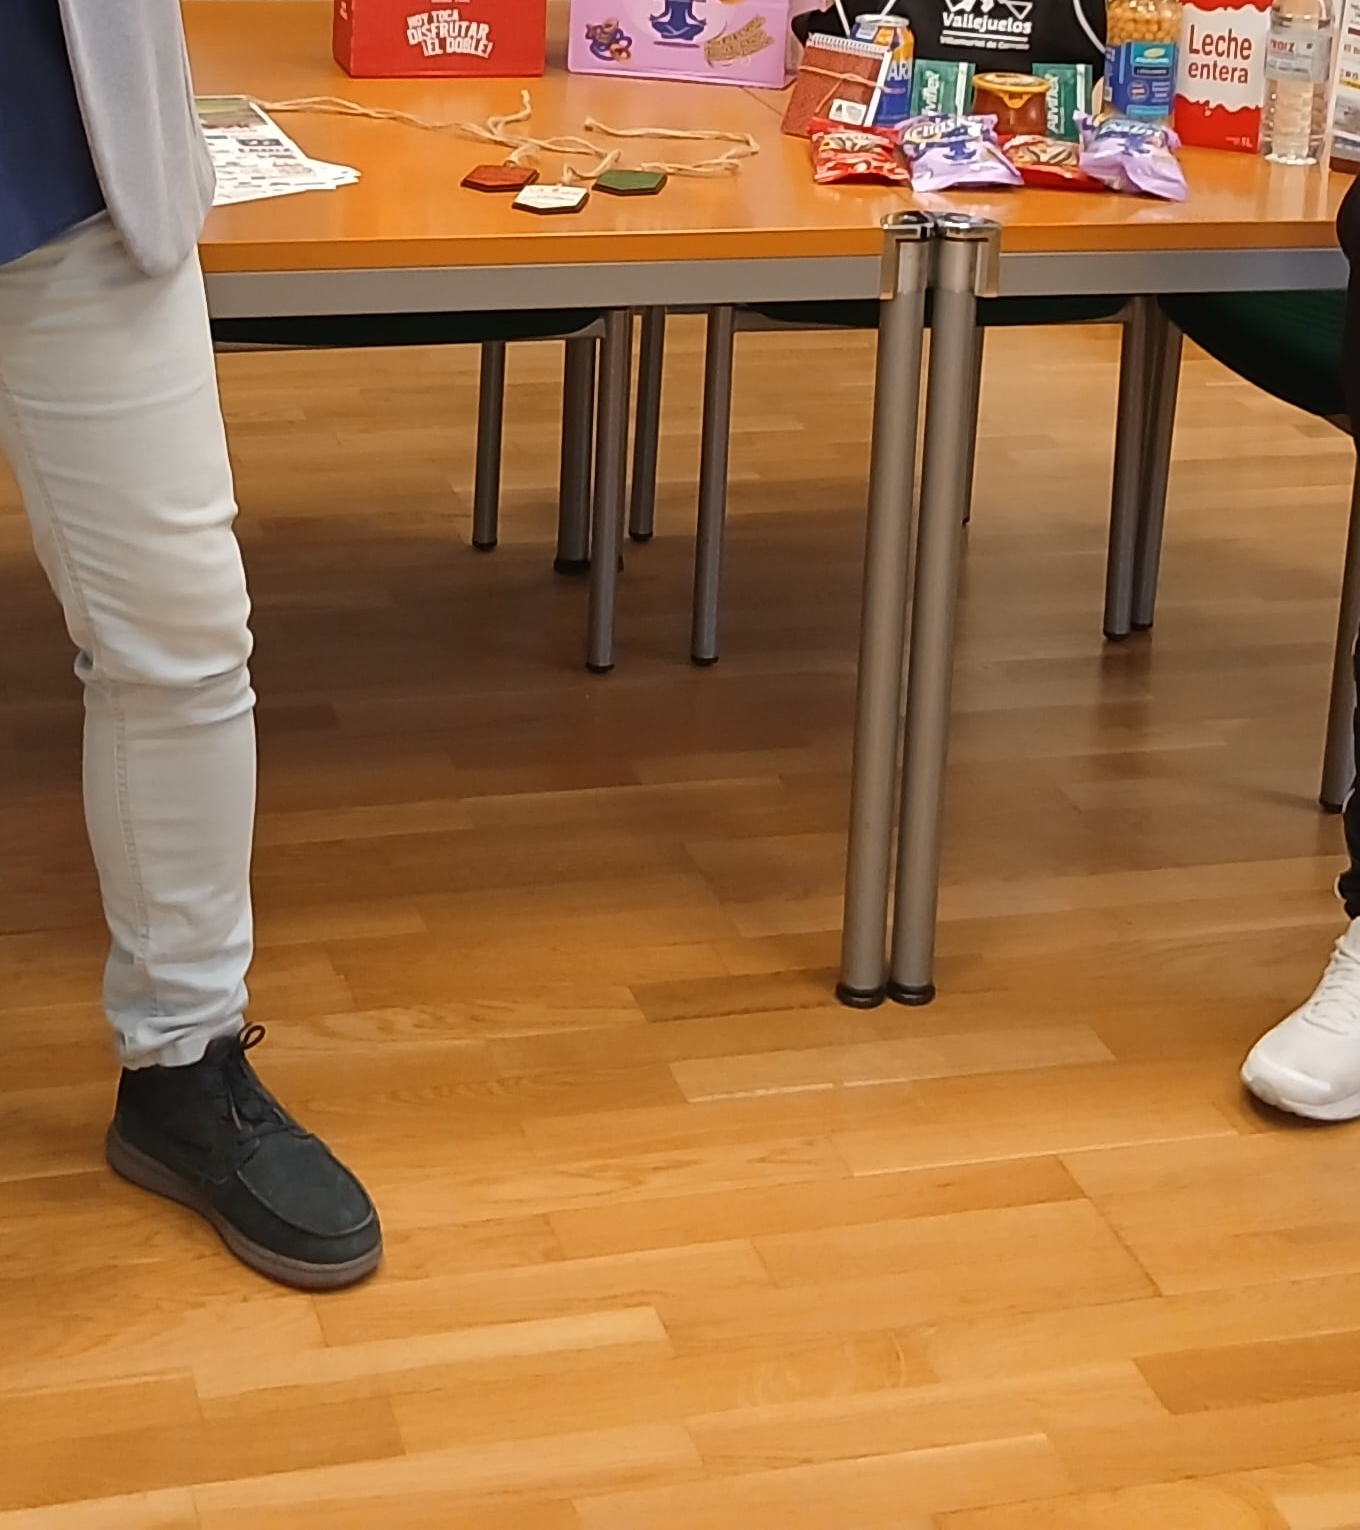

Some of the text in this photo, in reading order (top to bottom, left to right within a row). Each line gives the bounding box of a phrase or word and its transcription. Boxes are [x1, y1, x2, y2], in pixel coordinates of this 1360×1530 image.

[430, 8, 460, 23] TOCA
[942, 11, 1033, 35] Vallejuelos
[407, 20, 490, 46] DISFRUTAR
[1188, 24, 1253, 61] Leche
[1188, 60, 1250, 85] entera
